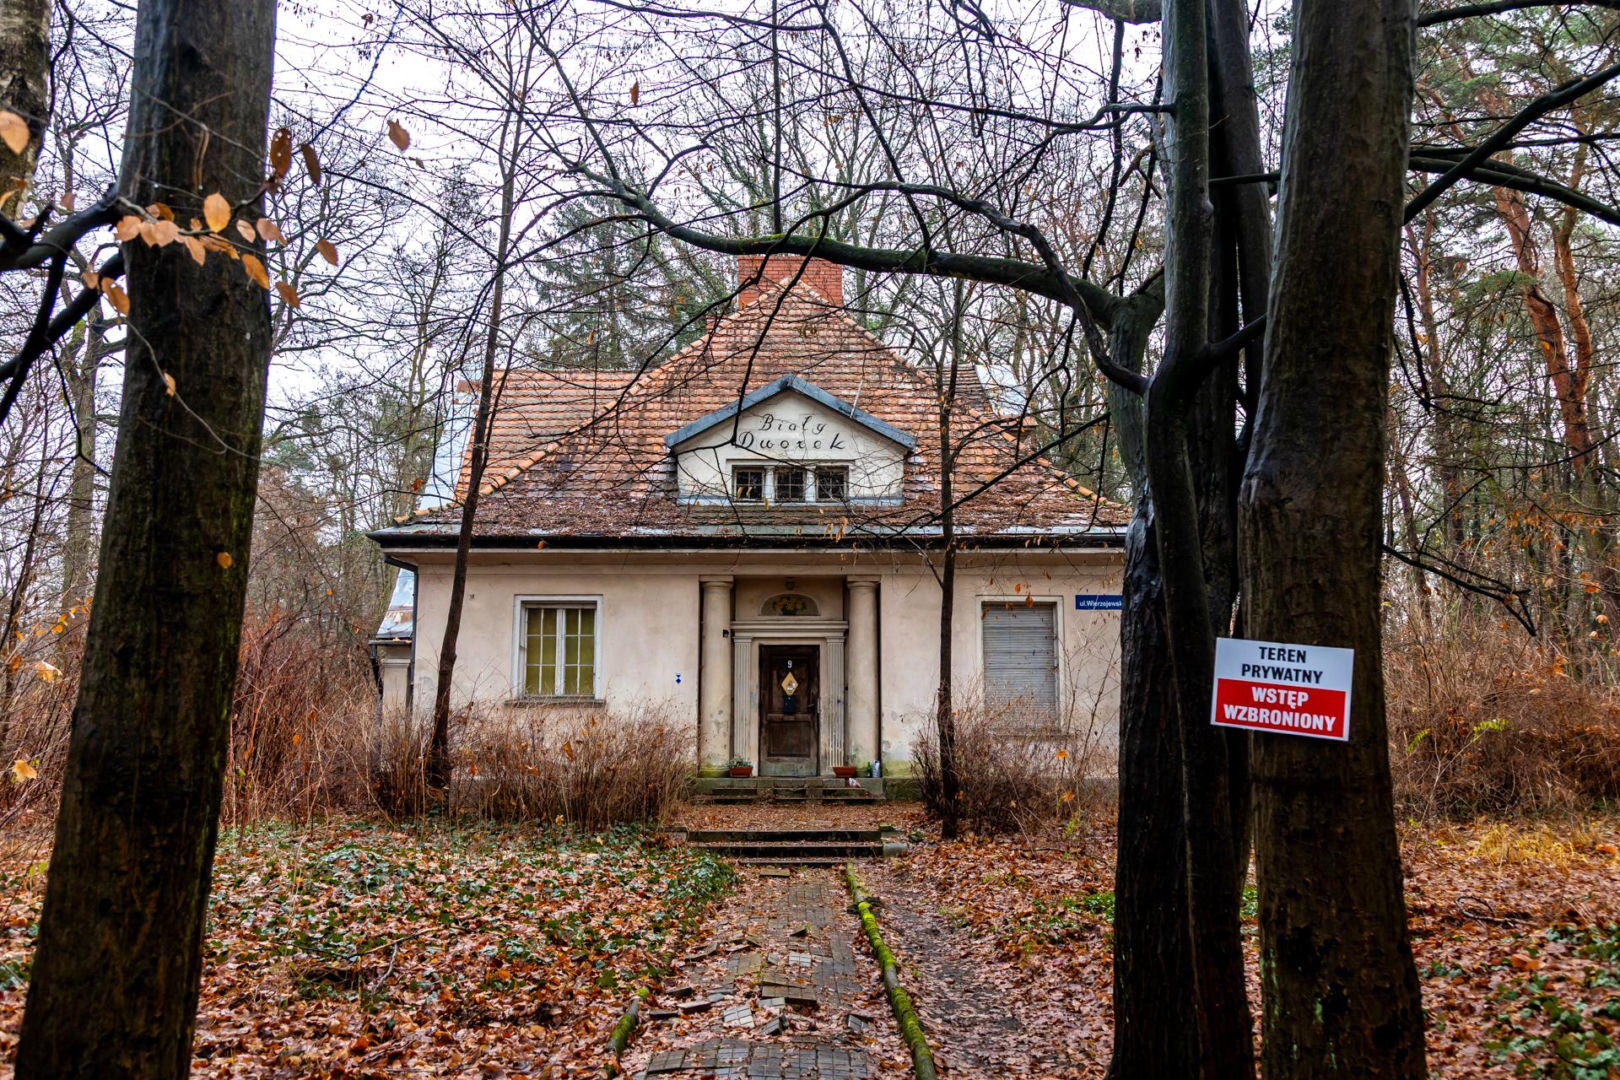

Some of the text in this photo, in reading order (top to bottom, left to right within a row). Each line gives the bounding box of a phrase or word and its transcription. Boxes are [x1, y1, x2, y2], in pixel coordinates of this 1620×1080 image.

[738, 431, 846, 450] Dworek
[1258, 646, 1307, 663] TEREN
[1241, 663, 1323, 684] PRYWATNY
[1251, 686, 1309, 709] WSTĘP
[1223, 703, 1336, 732] WZBRONIONY
